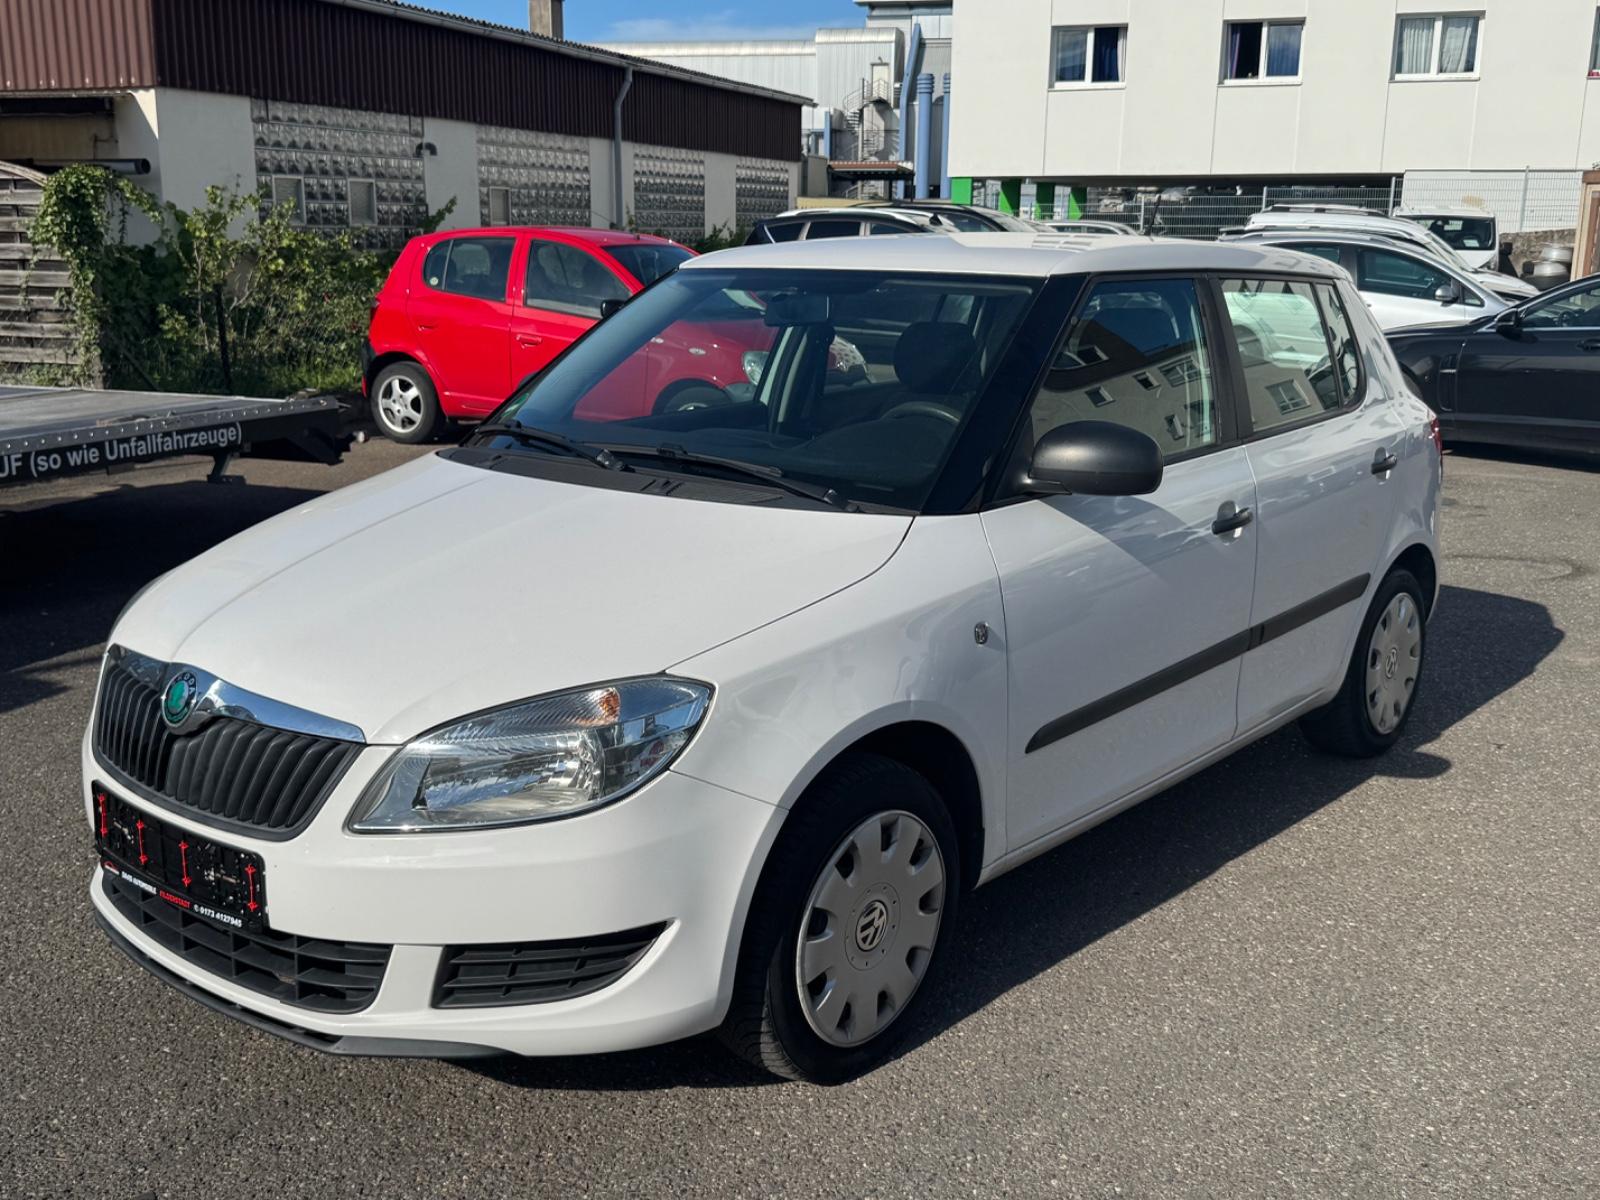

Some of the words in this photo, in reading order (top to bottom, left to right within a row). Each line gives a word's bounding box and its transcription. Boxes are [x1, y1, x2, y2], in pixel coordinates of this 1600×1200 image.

[30, 451, 62, 478] (so
[66, 444, 100, 467] wie
[105, 422, 243, 460] Unfallfahrzeuge)
